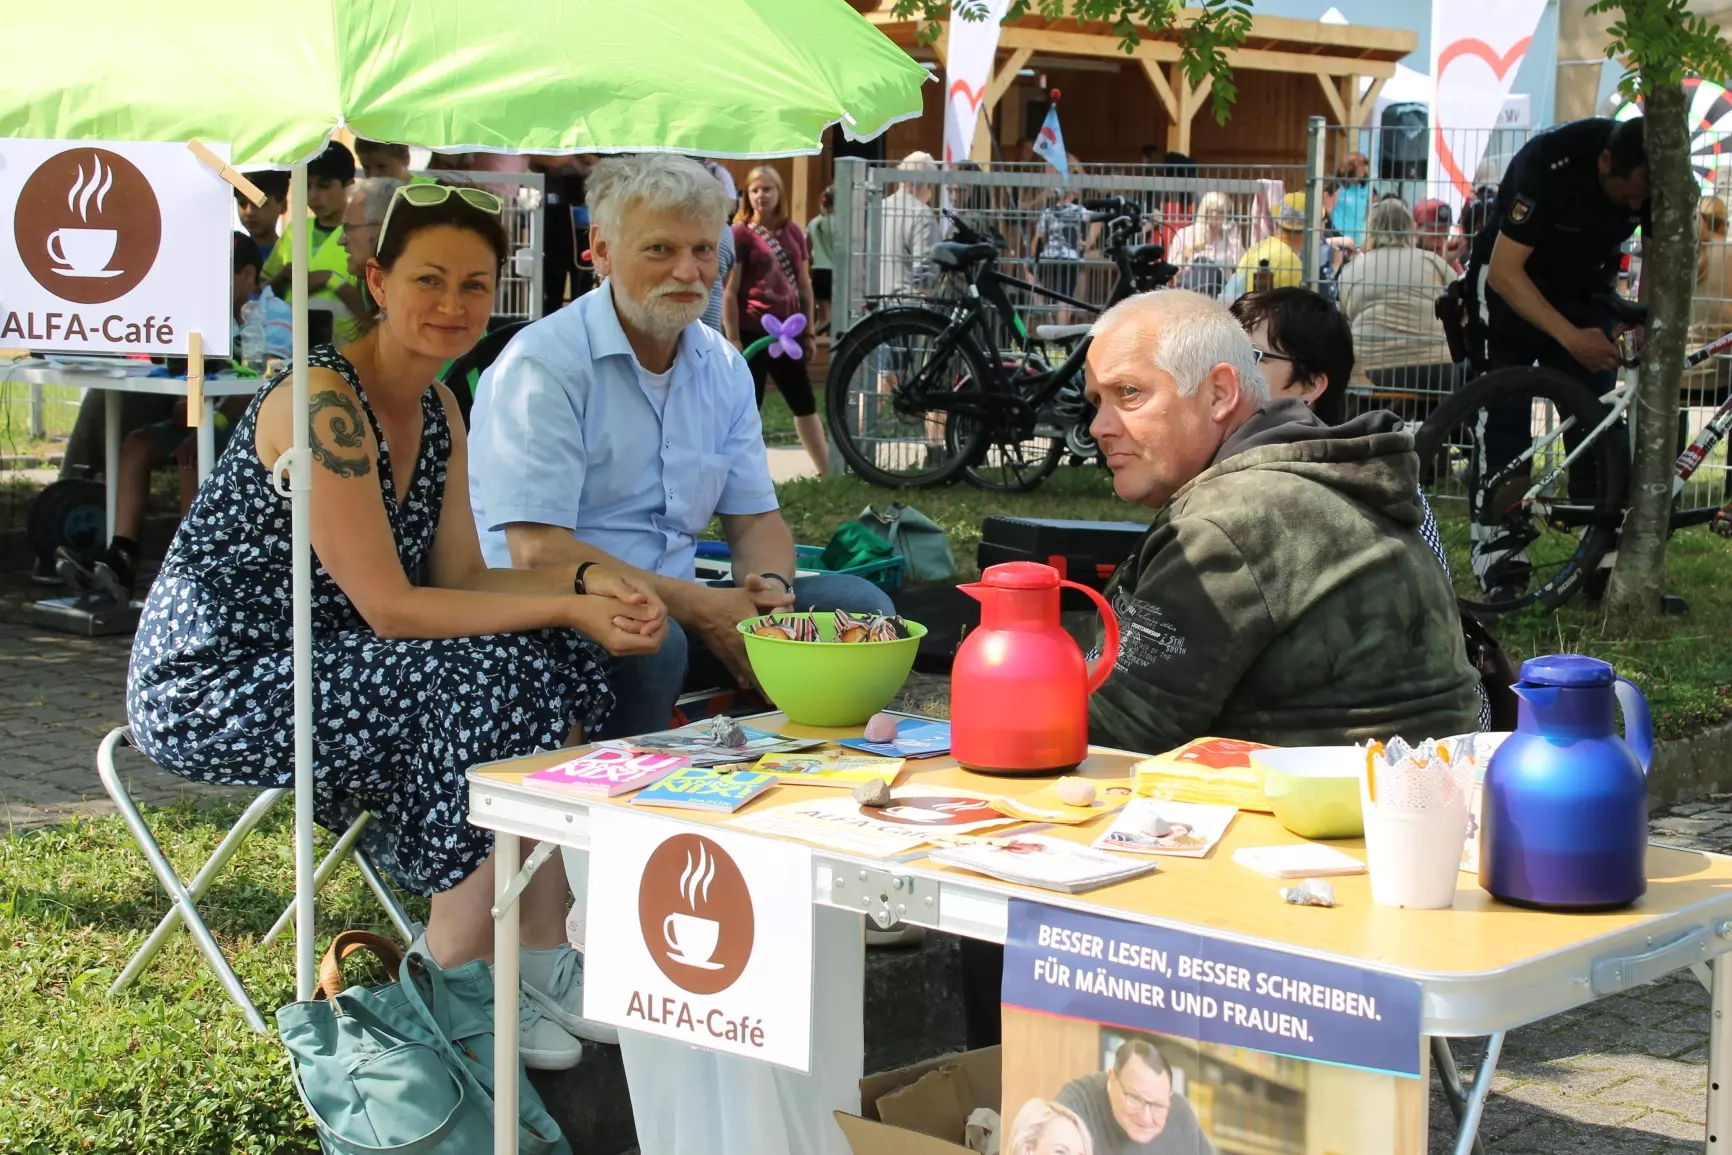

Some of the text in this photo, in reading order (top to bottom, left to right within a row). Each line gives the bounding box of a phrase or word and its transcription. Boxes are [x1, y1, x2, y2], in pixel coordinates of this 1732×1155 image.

[0, 311, 174, 345] ALFA-Café
[1166, 645, 1187, 655] SOUTH
[577, 747, 683, 770] DU
[666, 767, 773, 785] DU
[1038, 924, 1382, 1021] BESSER LESEN, BESSER SCHREIBEN.
[1034, 956, 1314, 1042] FÜR MÄNNER UND FRAUEN.
[626, 990, 765, 1047] ALFA-Café
